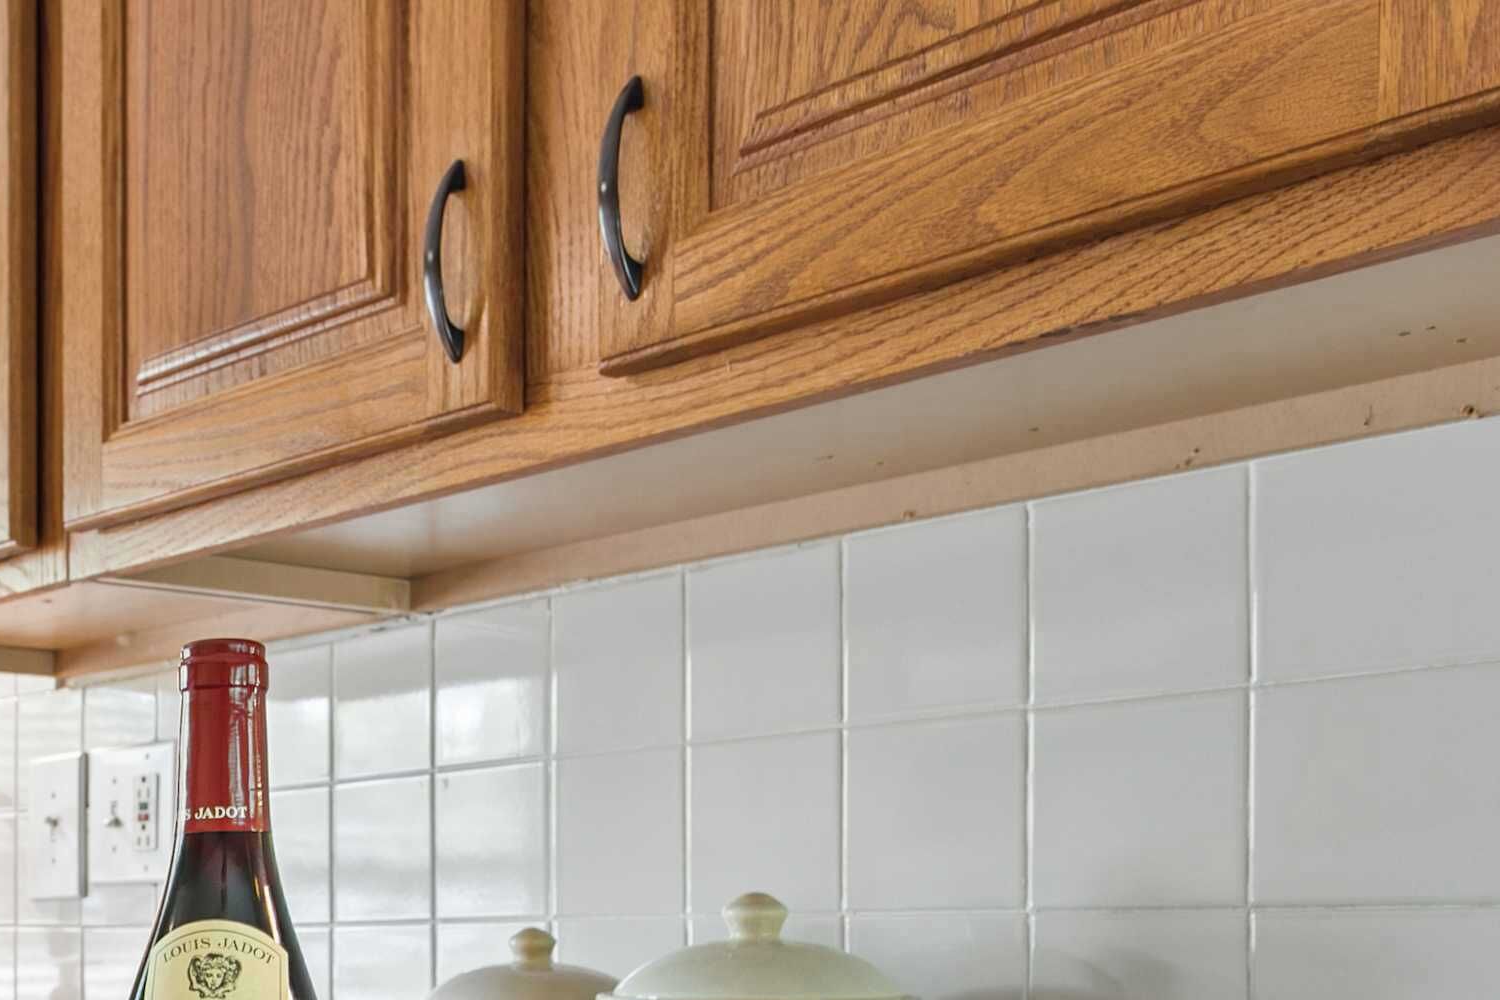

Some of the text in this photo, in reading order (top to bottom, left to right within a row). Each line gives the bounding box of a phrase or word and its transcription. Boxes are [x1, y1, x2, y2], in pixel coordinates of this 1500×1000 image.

[194, 805, 248, 820] JADOT
[162, 937, 276, 965] LOUIS JADOT
